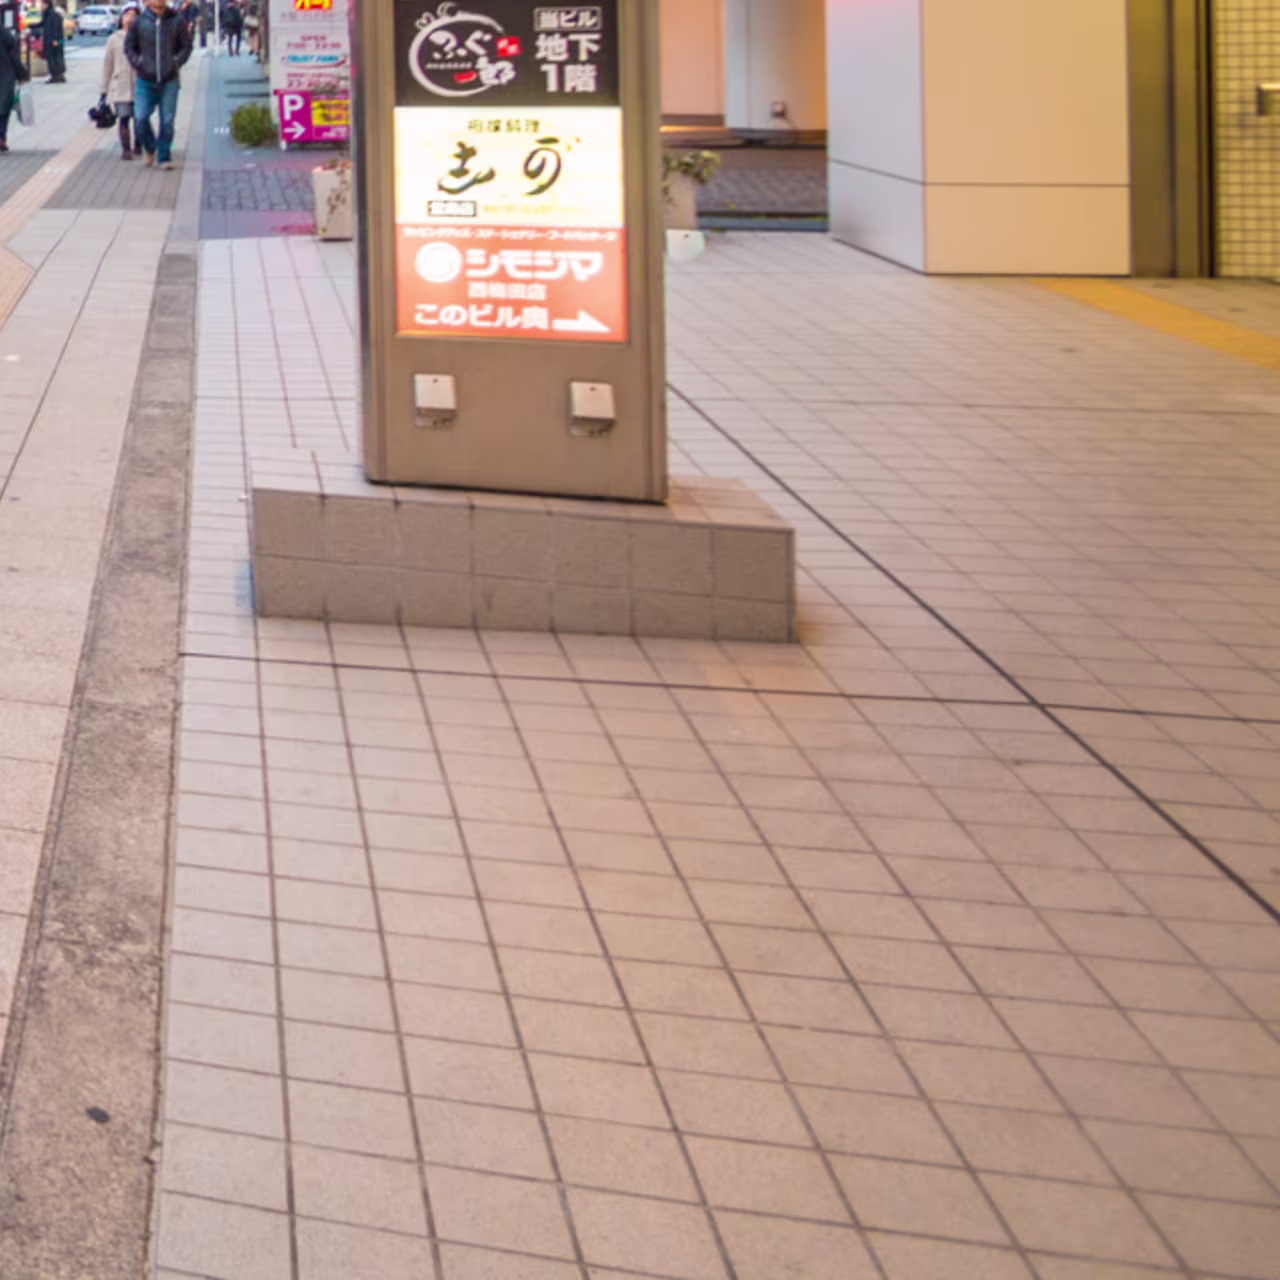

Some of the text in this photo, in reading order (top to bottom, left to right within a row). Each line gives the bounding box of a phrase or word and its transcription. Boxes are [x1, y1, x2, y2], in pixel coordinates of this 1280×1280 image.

[539, 9, 598, 28] 当ビル
[534, 33, 602, 62] 地下
[540, 63, 598, 93] 1階
[283, 94, 305, 121] P
[465, 248, 603, 282] シモジマ
[467, 281, 547, 301] 西梅田店
[414, 303, 549, 330] このビル奥
